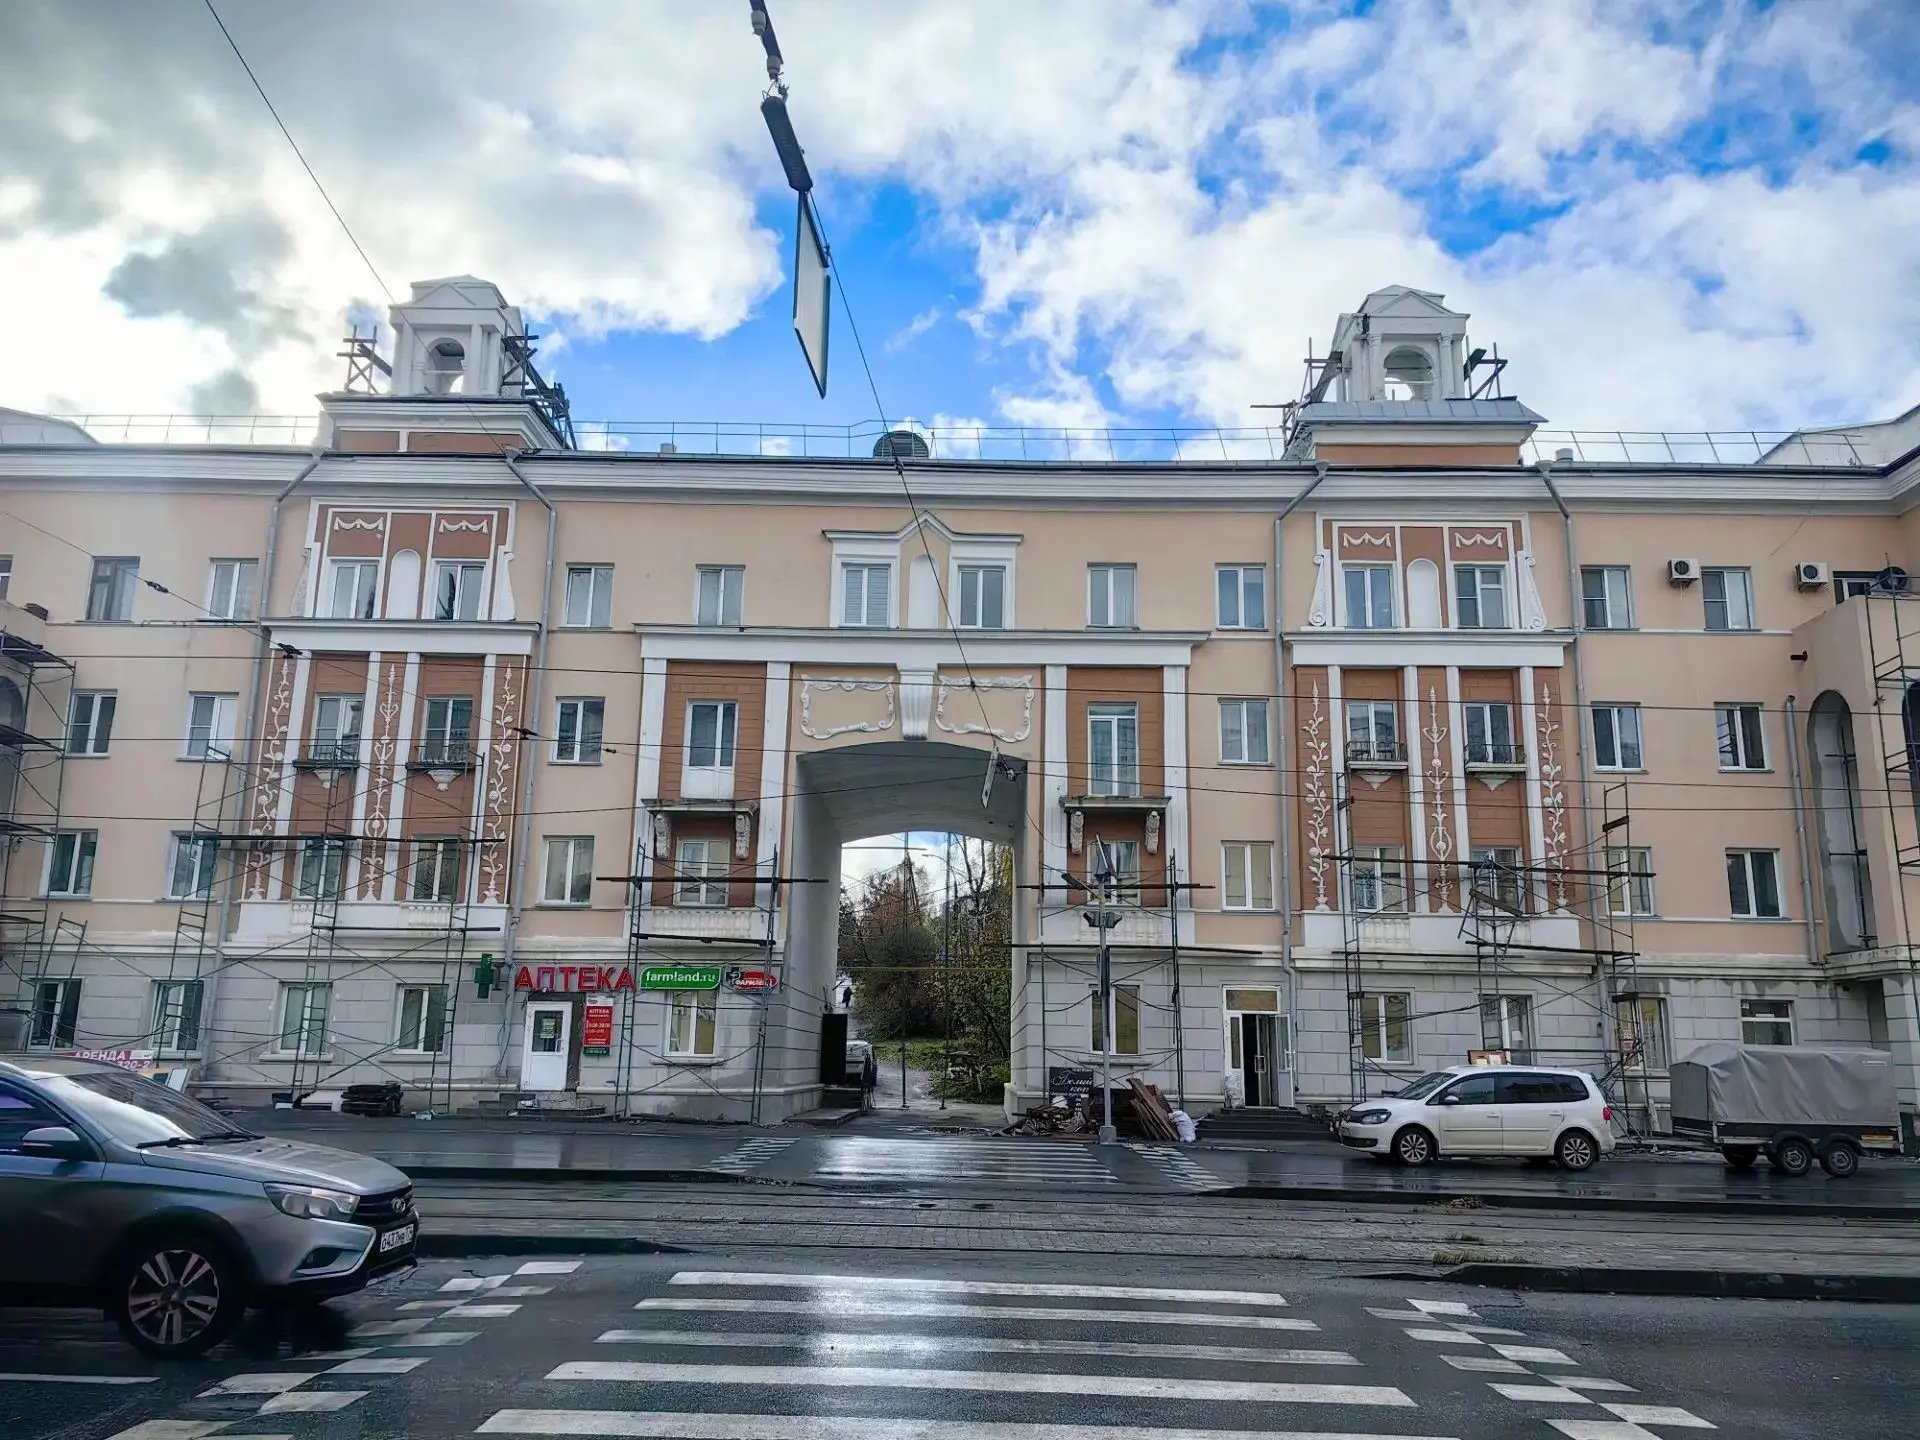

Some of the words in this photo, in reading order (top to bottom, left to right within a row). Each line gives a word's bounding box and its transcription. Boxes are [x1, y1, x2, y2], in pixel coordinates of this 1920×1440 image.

[514, 966, 636, 991] АПТЕКА
[646, 971, 716, 982] farmland.ru
[75, 1050, 126, 1060] АРЕНДА
